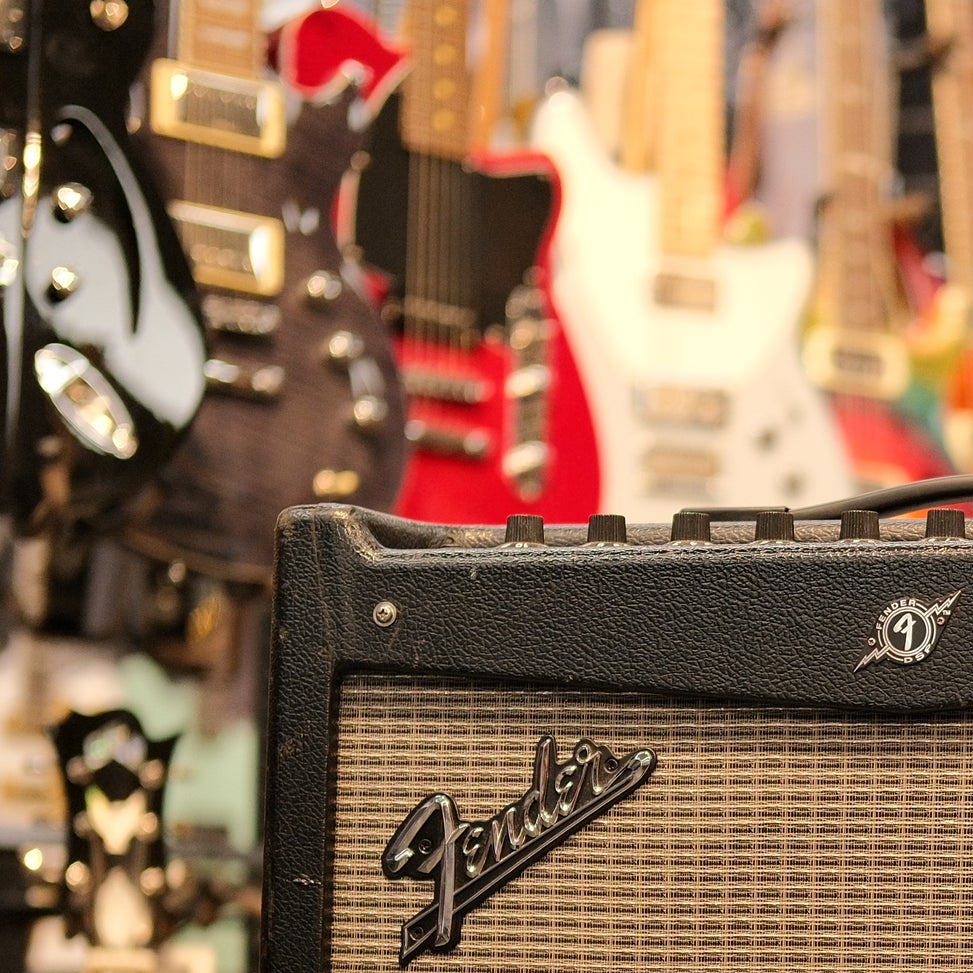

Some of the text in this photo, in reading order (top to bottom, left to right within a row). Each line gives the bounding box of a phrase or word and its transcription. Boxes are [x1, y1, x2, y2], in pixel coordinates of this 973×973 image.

[875, 599, 917, 631] FENDER
[903, 643, 931, 664] DSP
[382, 735, 656, 967] Fender
